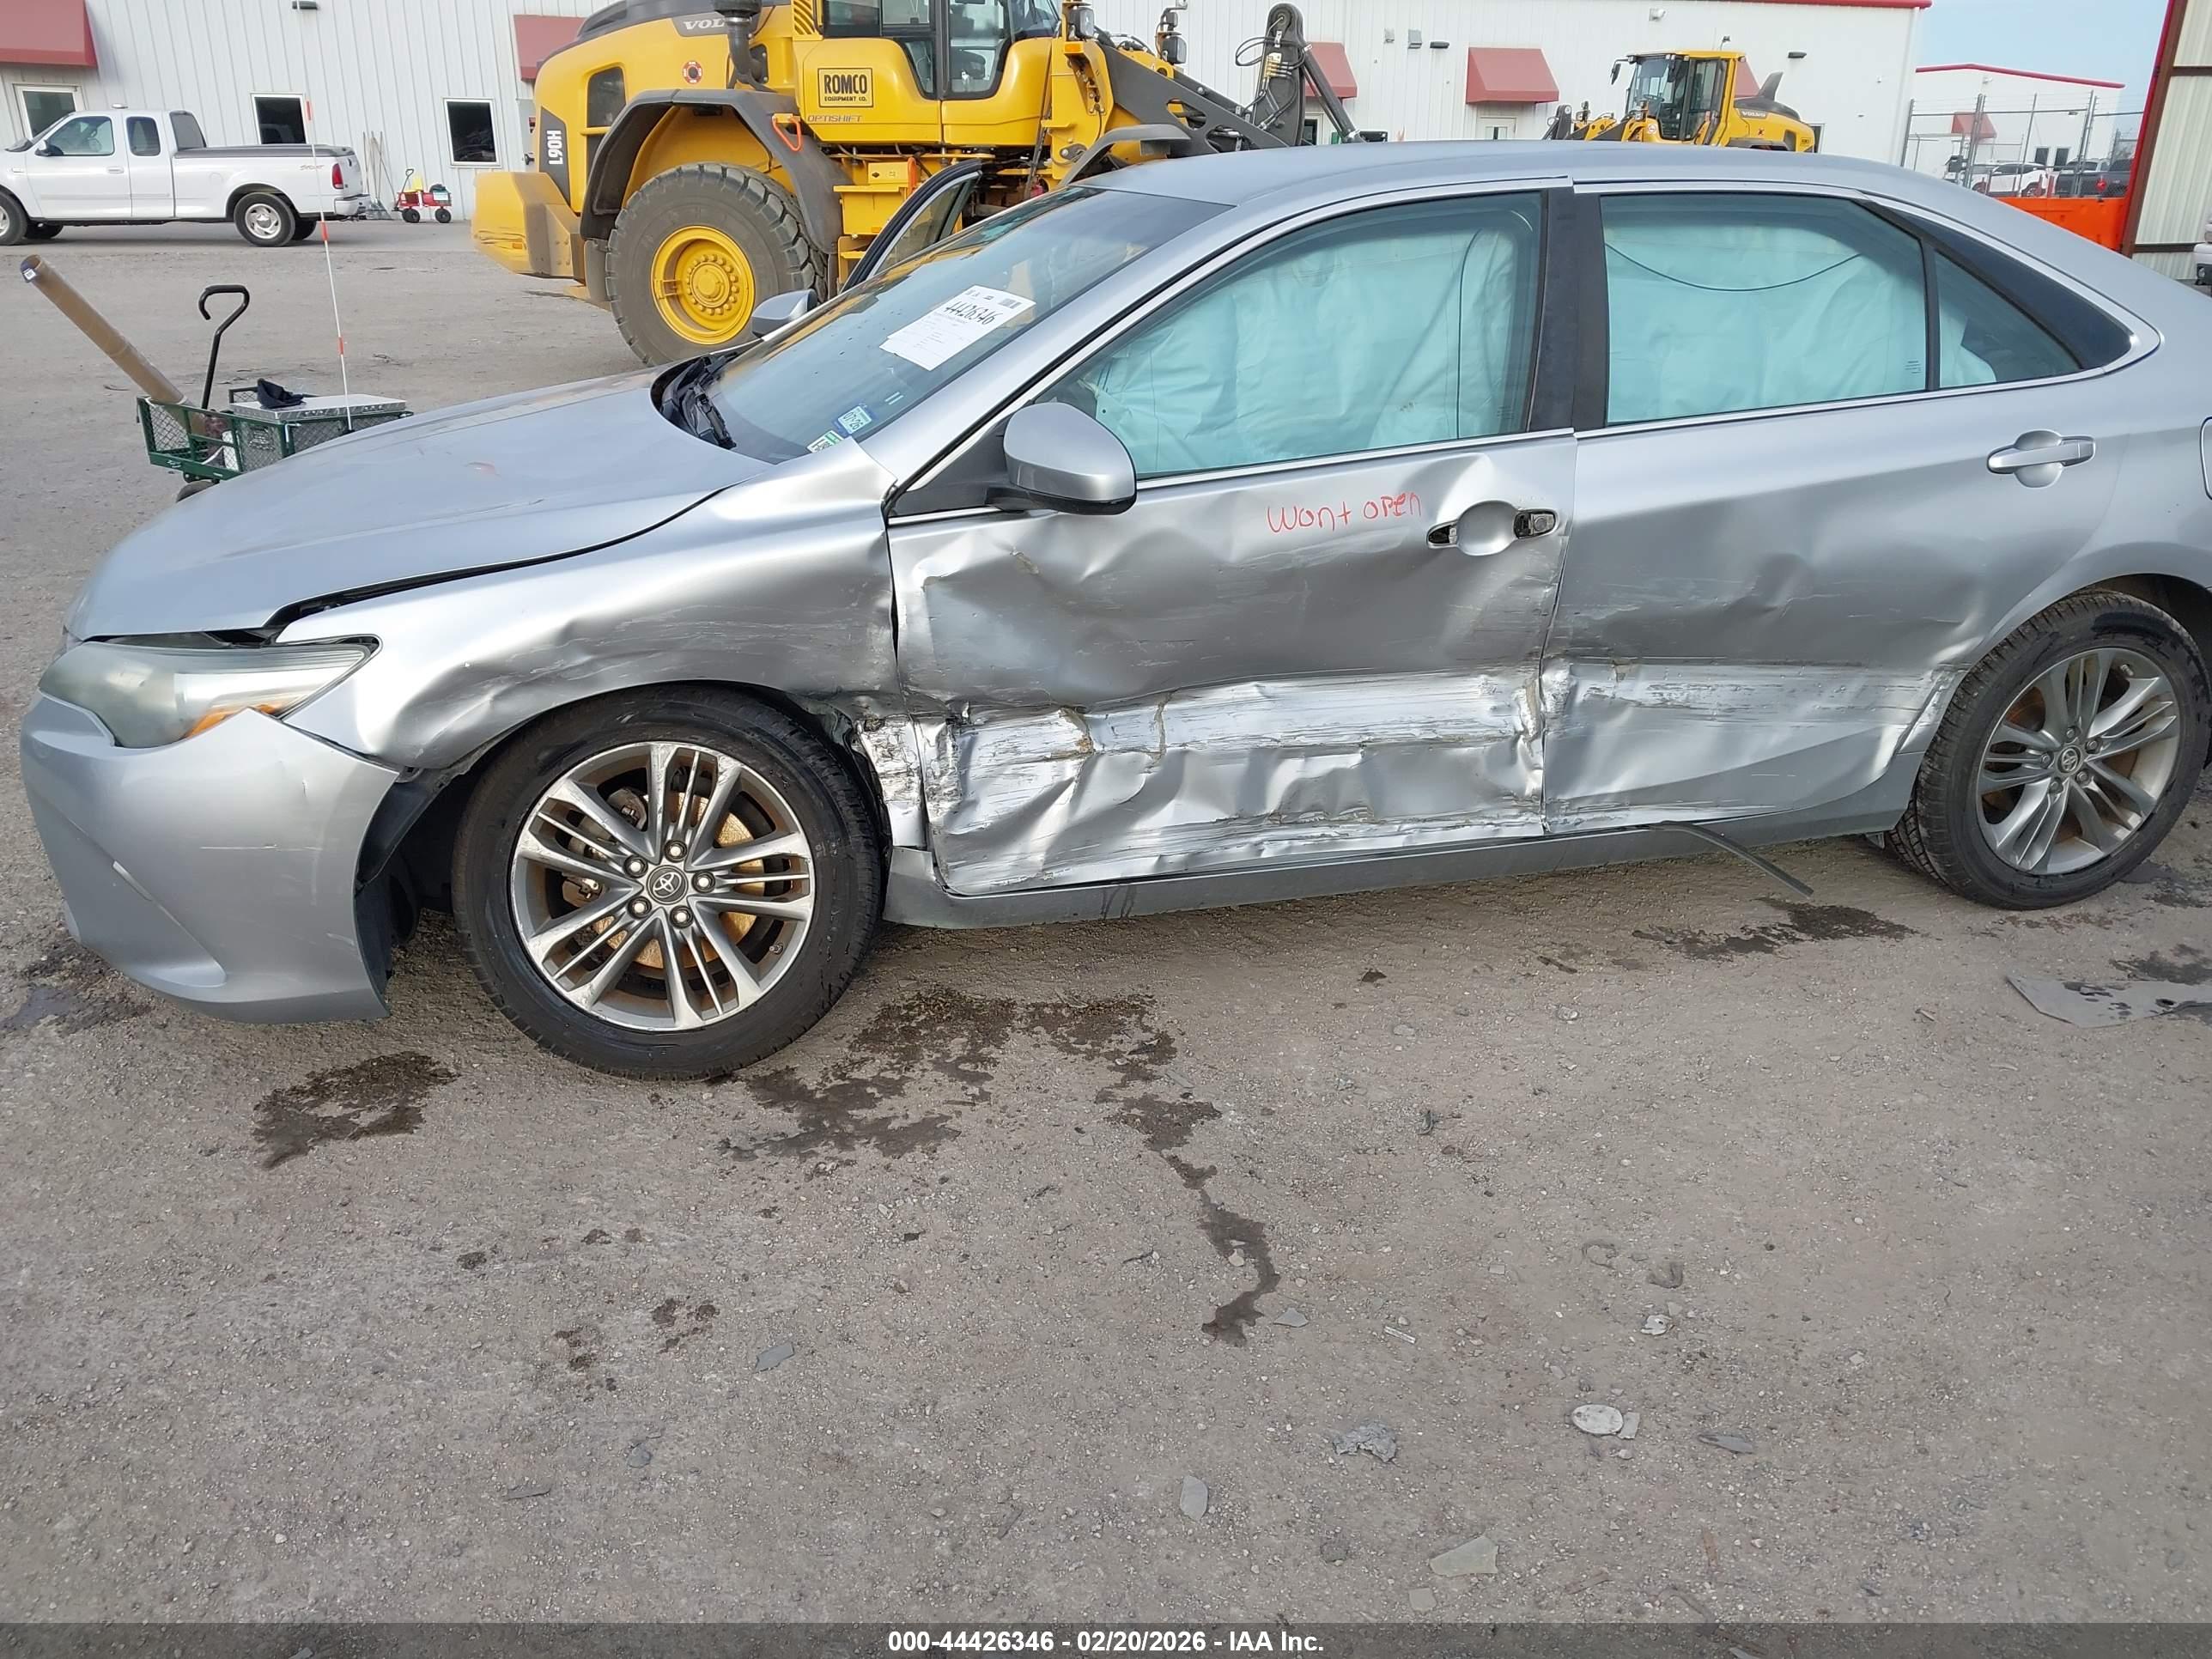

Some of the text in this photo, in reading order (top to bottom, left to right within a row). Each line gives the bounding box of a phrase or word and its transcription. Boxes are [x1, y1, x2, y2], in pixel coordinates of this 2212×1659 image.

[684, 17, 725, 30] VOL
[823, 74, 867, 94] ROMCO
[546, 130, 563, 165] L90H
[944, 301, 1003, 325] 44426346
